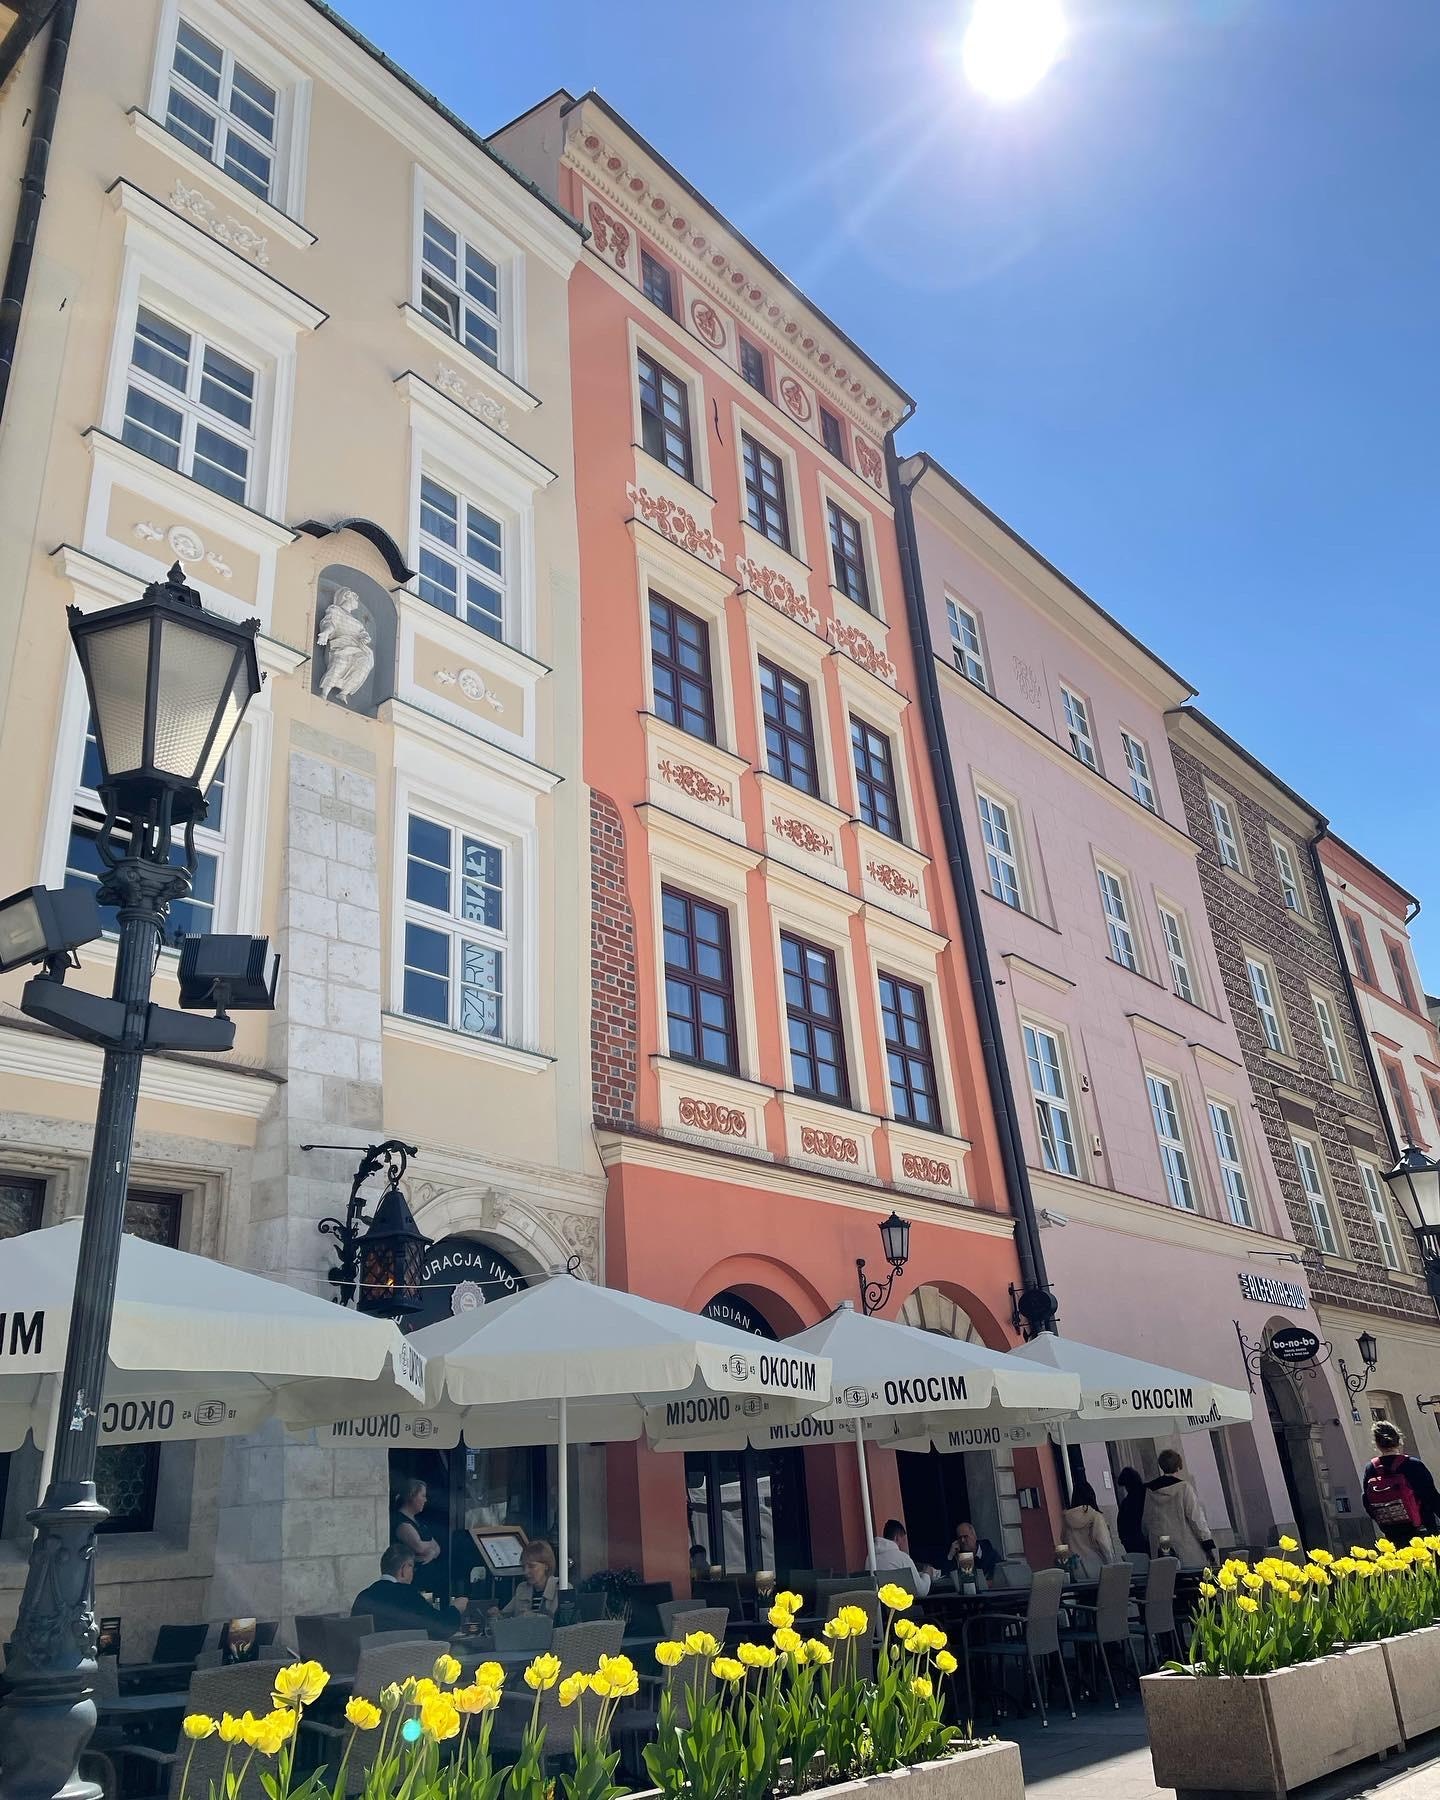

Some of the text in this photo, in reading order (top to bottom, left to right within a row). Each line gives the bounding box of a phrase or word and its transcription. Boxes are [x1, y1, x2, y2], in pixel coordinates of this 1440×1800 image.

[489, 1261, 520, 1293] IND
[708, 1305, 751, 1329] INDIAN
[760, 1355, 816, 1392] OKOCIM
[884, 1375, 968, 1406] OKOCIM
[1131, 1388, 1194, 1411] OKOCIM
